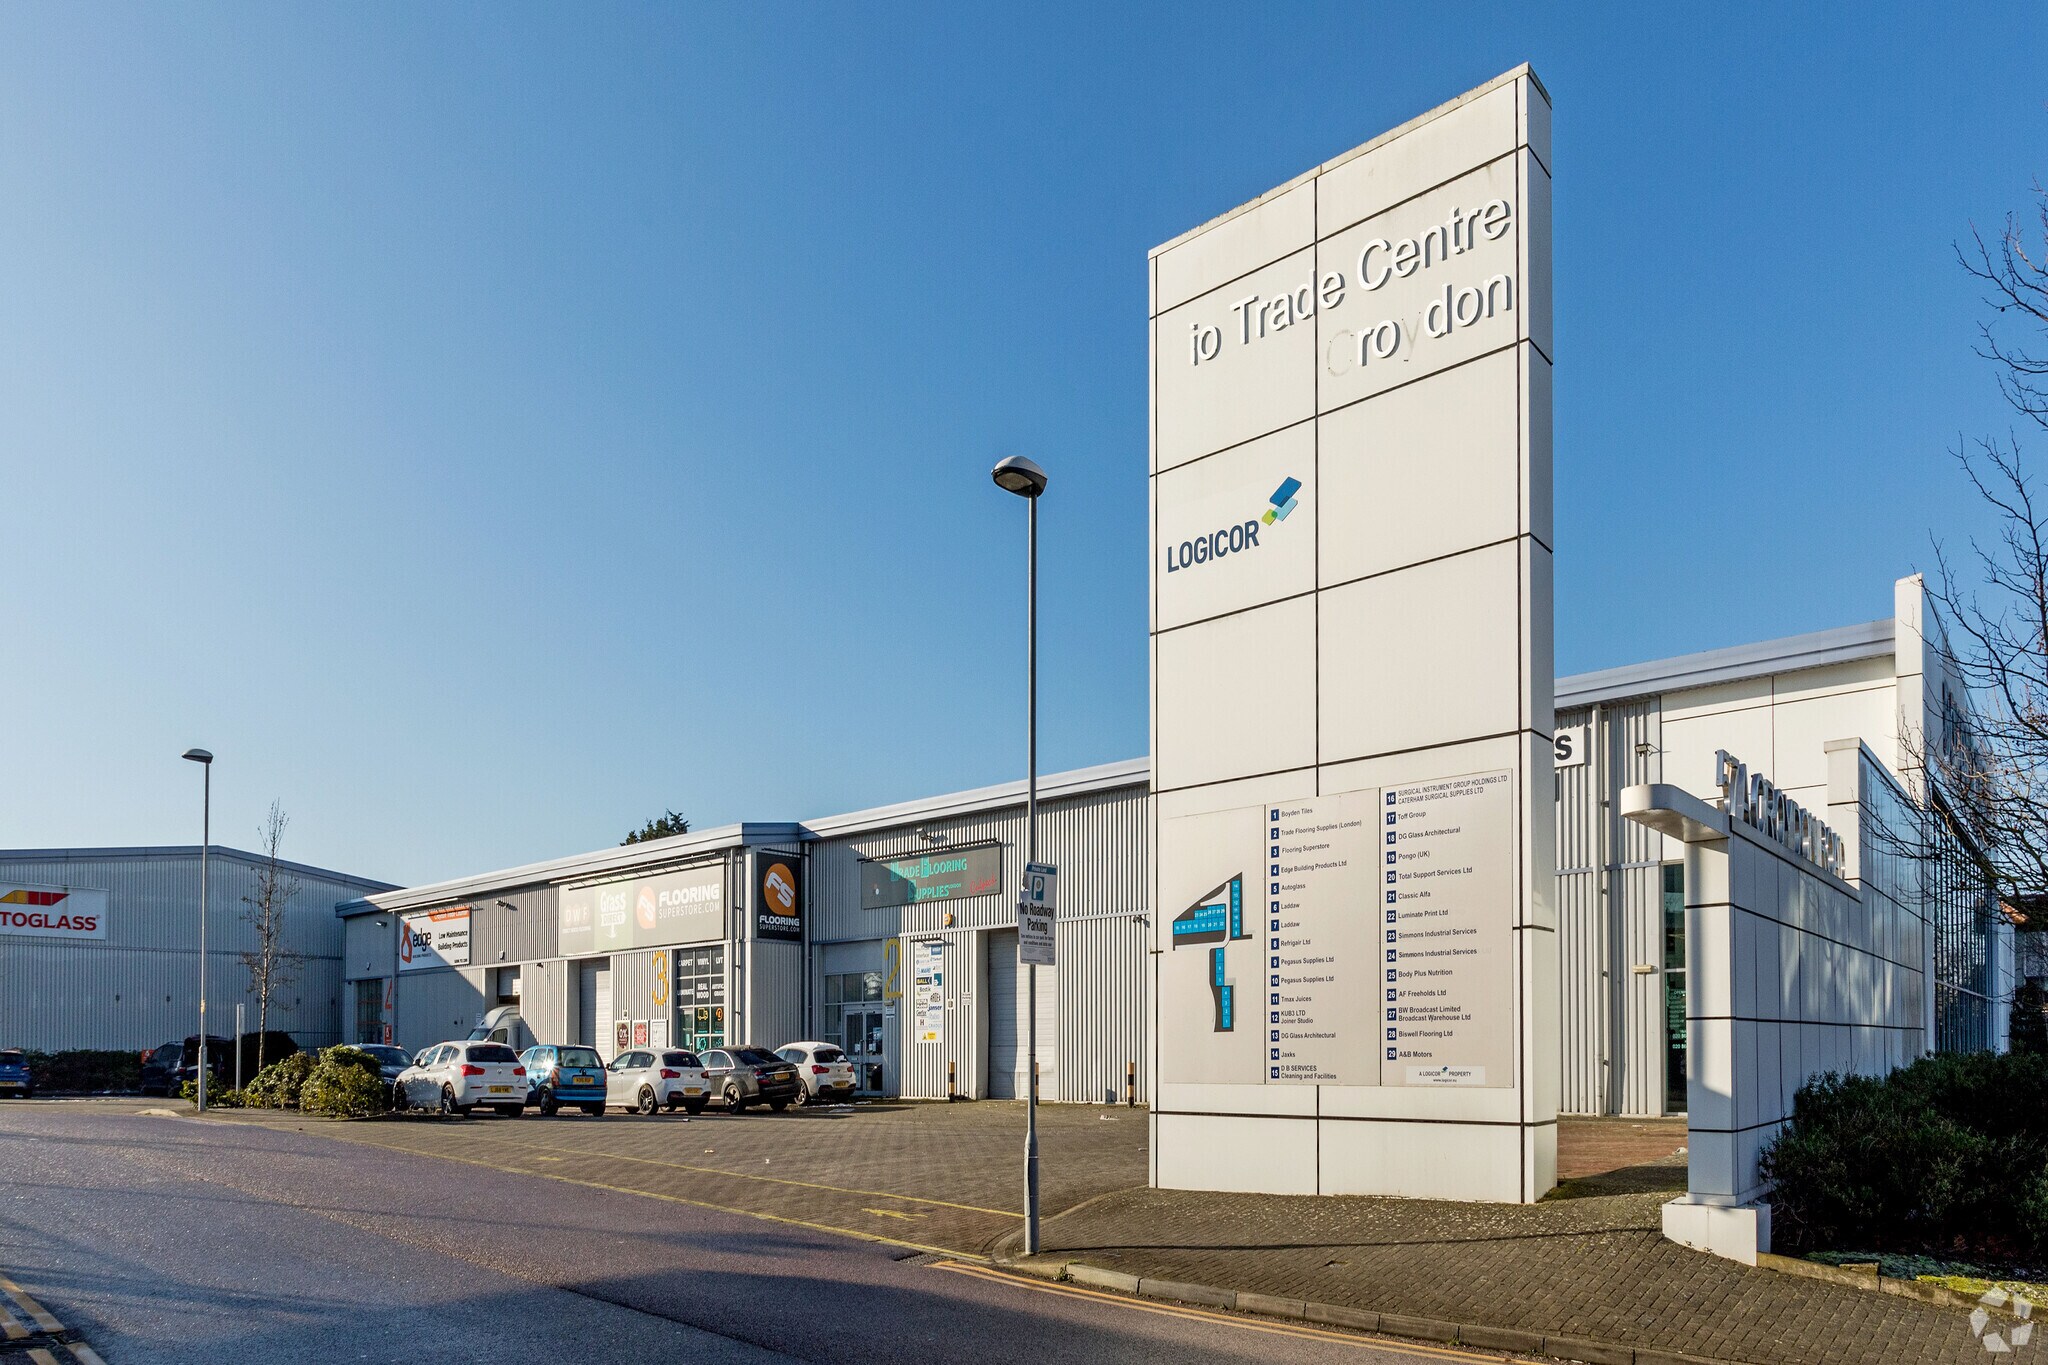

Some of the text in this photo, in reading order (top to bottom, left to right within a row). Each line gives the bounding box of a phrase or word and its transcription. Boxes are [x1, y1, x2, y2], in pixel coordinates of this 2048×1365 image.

[1189, 198, 1510, 366] io Trade Centre
[1167, 520, 1259, 572] LOGICOR
[1398, 788, 1421, 797] SURGICAL
[1422, 783, 1452, 793] INSTRUMENT
[1453, 780, 1470, 788] GROUP
[1471, 777, 1497, 786] HOLDINGS
[1387, 794, 1395, 802] 16
[1398, 795, 1424, 805] CATERHAM
[1425, 792, 1448, 802] SURGICAL
[1450, 789, 1473, 799] SUPPLIES
[1282, 809, 1300, 818] Boyden
[1339, 820, 1362, 829] (London)
[1424, 827, 1460, 837] Architectural
[1303, 843, 1330, 851] Superstore
[920, 856, 967, 878] FLOORING
[1294, 863, 1314, 871] Building
[1413, 871, 1436, 879] Support
[1437, 868, 1461, 877] Services
[659, 883, 720, 907] FLOORING
[908, 879, 949, 902] SUPPLIES
[600, 891, 627, 912] Grass
[658, 902, 720, 919] SUPERSTORE.COM
[1020, 903, 1054, 920] No Roadway
[759, 915, 800, 926] FLOORING
[1027, 918, 1048, 935] Parking
[413, 928, 431, 951] edge
[884, 938, 903, 999] 2
[1399, 970, 1412, 979] Body
[1414, 970, 1426, 978] Plus
[1428, 968, 1453, 976] Nutrition
[652, 951, 669, 1006] 3
